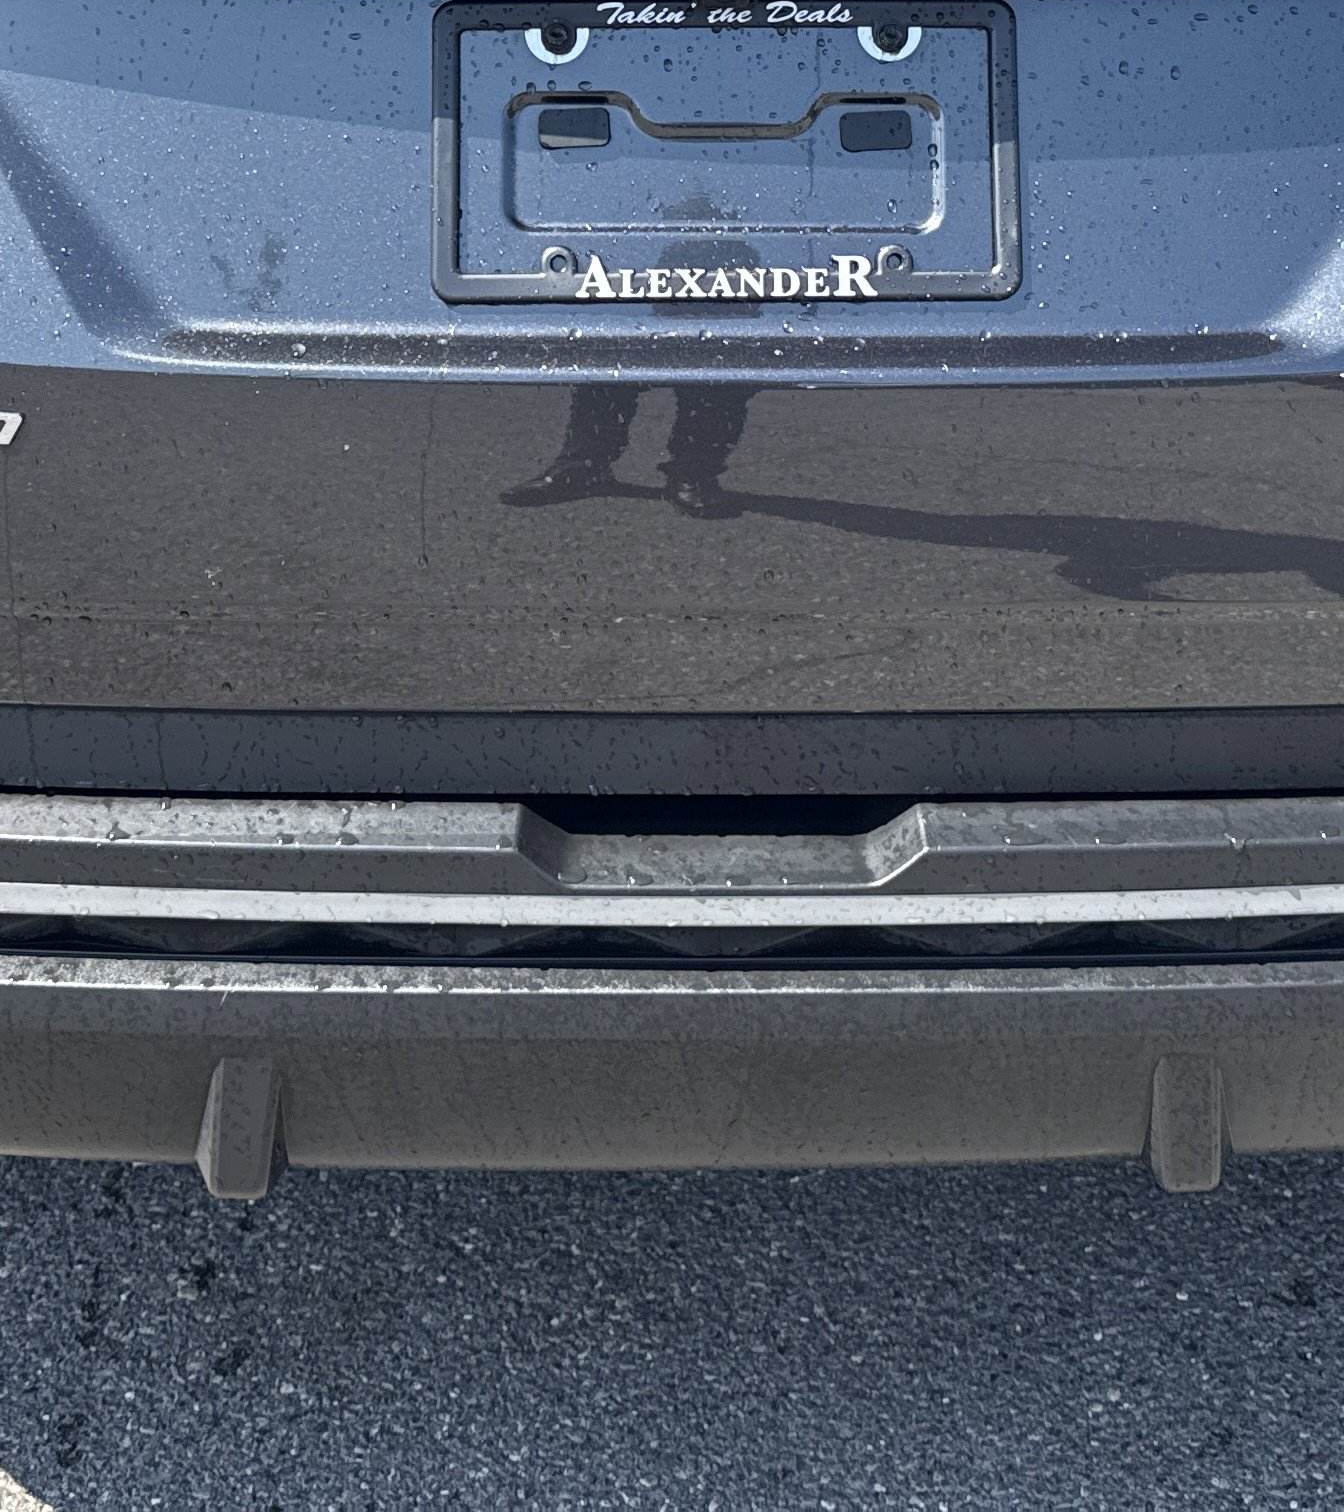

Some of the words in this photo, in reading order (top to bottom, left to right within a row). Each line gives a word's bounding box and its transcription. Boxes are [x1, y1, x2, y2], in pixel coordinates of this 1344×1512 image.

[597, 0, 697, 24] Takin'
[707, 7, 752, 24] the
[765, 0, 854, 24] Deals
[576, 255, 878, 299] ALEXANDER
